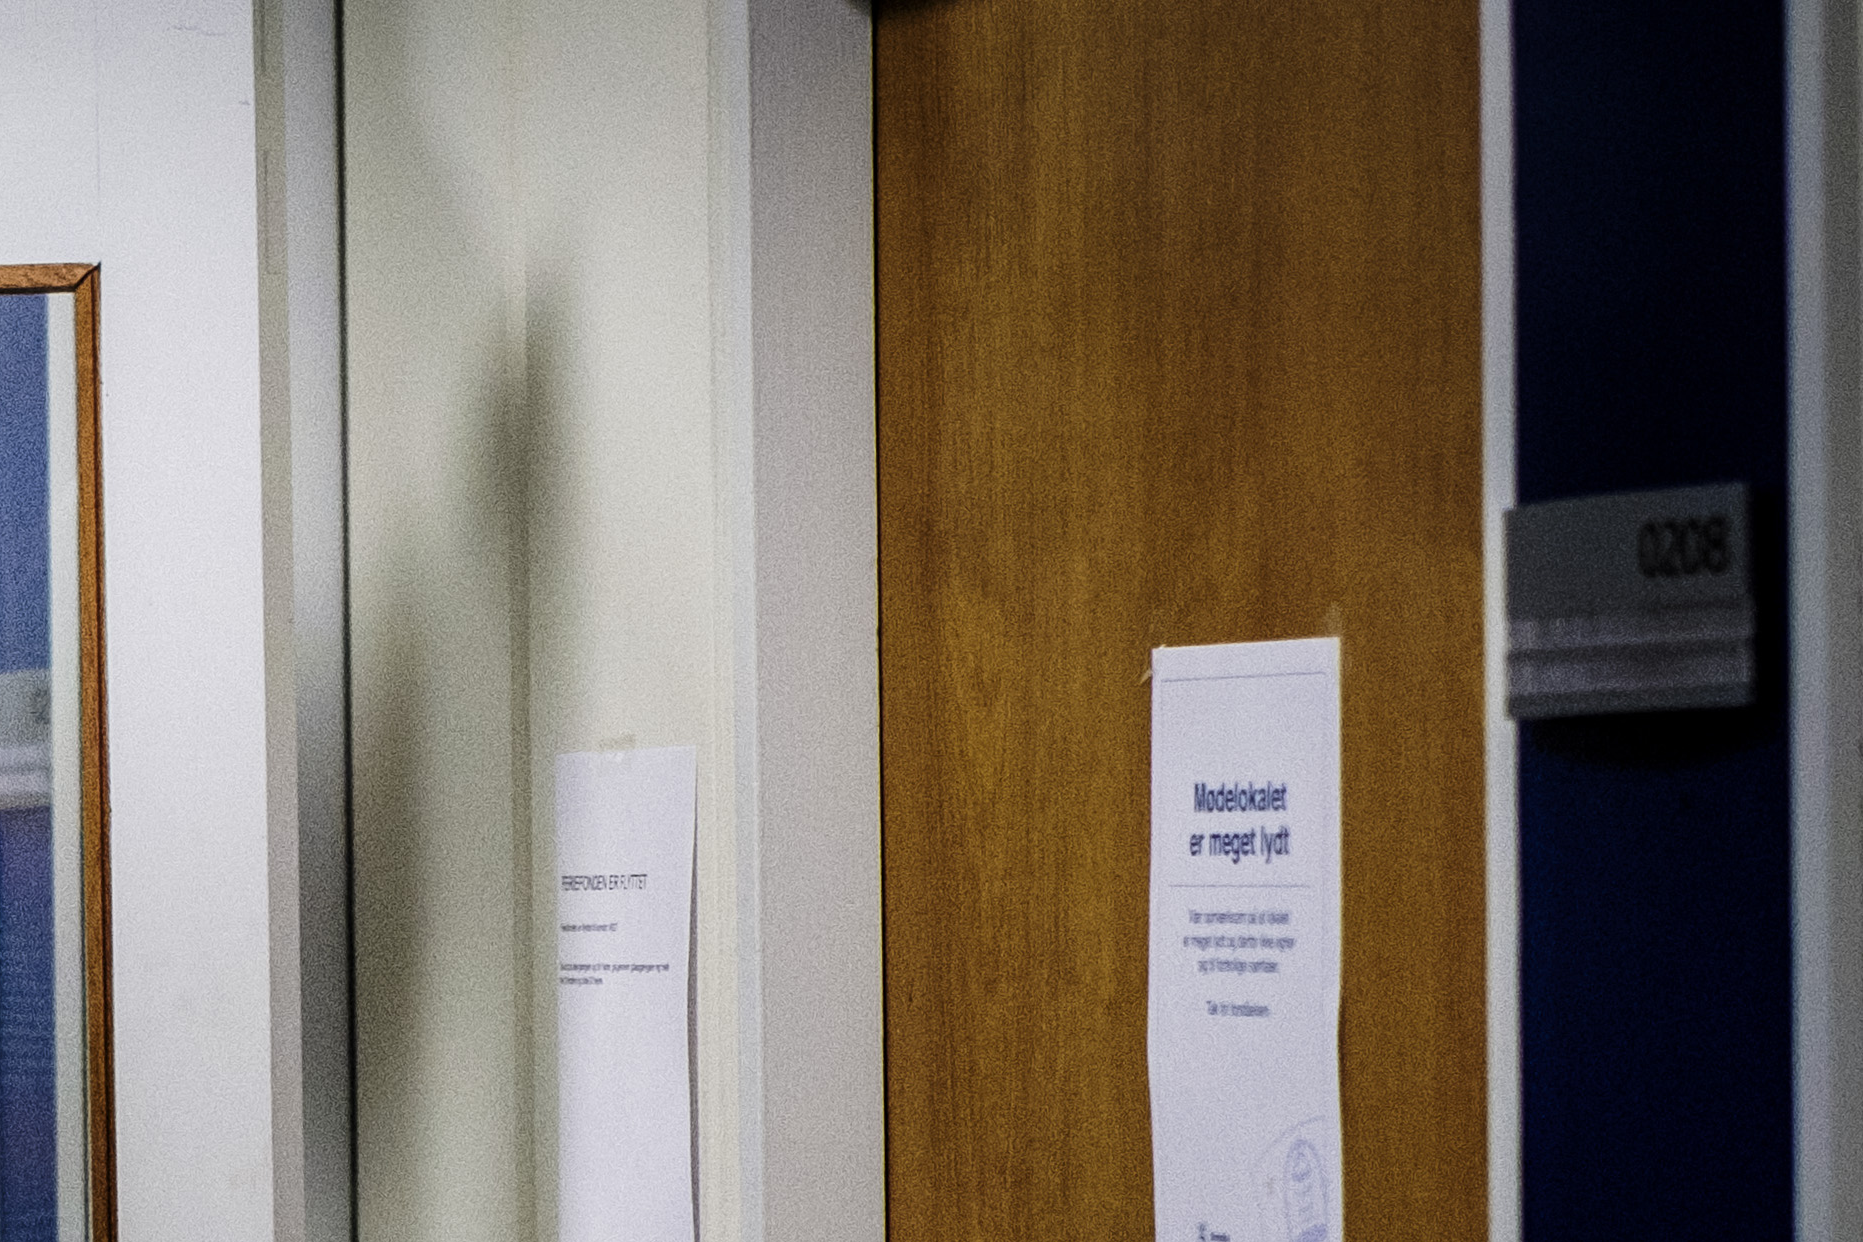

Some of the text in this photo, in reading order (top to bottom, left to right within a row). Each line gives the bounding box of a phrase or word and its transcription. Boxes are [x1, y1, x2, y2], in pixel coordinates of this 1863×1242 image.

[1193, 780, 1287, 813] Mødelokalet
[1190, 825, 1290, 865] er meget lydt
